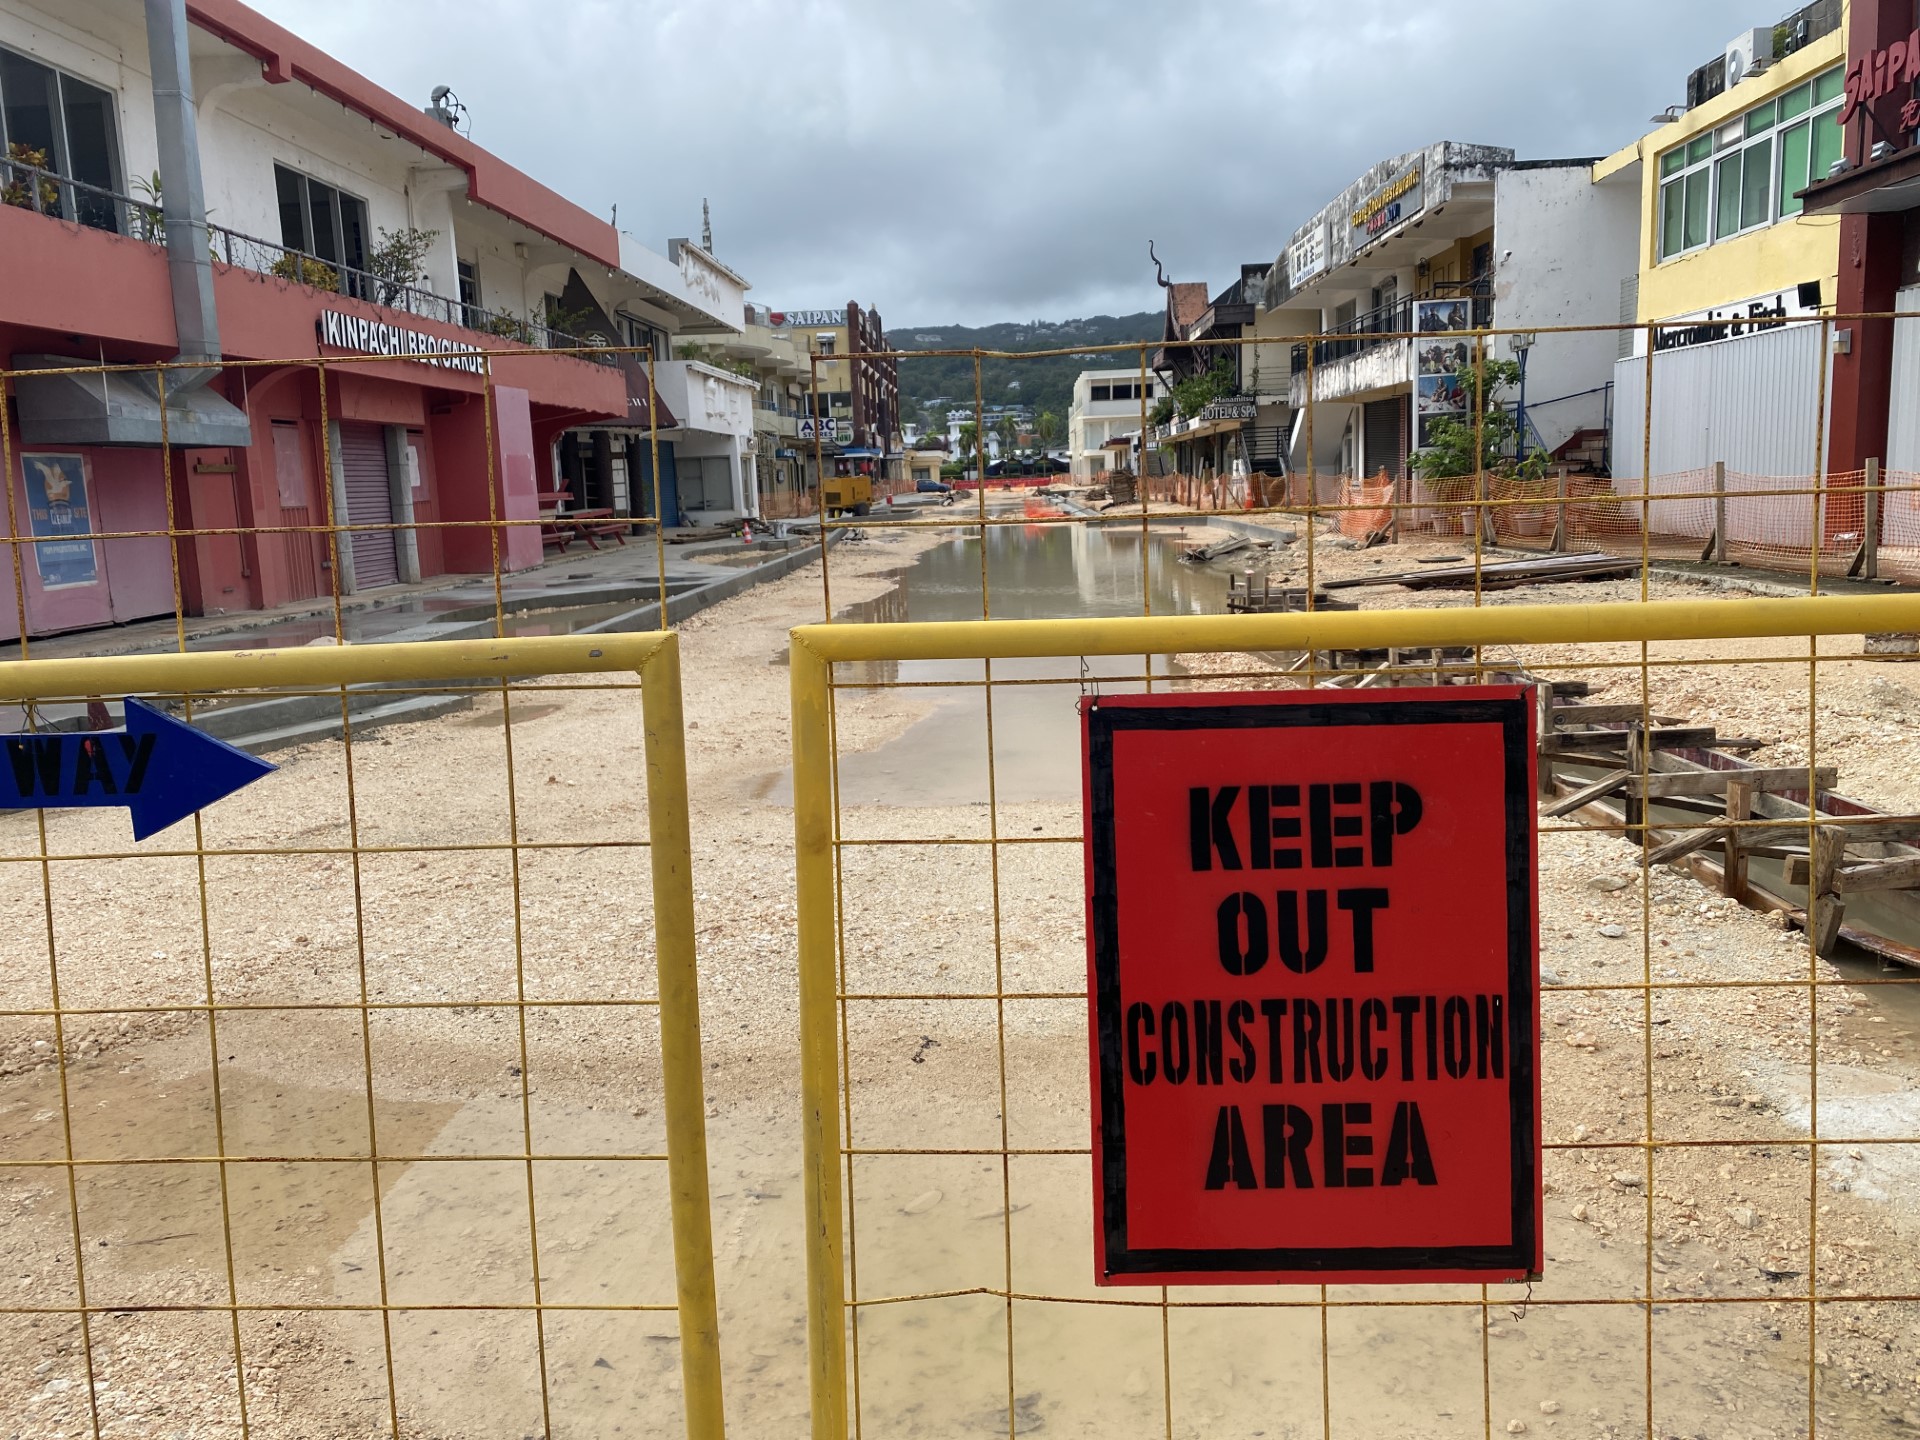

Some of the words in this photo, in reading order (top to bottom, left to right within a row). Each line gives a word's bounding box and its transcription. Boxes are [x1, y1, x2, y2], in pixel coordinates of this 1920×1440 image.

[322, 309, 405, 356] KINPACHI
[407, 330, 438, 368] BBQ
[786, 310, 842, 325] SAIPAN
[1731, 312, 1745, 337] &
[1748, 294, 1787, 334] Fitch
[801, 419, 835, 432] ABC
[1200, 407, 1231, 420] HOTEL
[1231, 407, 1239, 418] &
[1240, 405, 1257, 418] SPA
[1215, 395, 1255, 403] Hanamitsu
[6, 733, 157, 797] WAY
[1189, 781, 1424, 871] KEEP
[1217, 888, 1390, 976] OUT
[1127, 994, 1505, 1086] CONSTRUCTION
[1205, 1101, 1439, 1190] AREA
